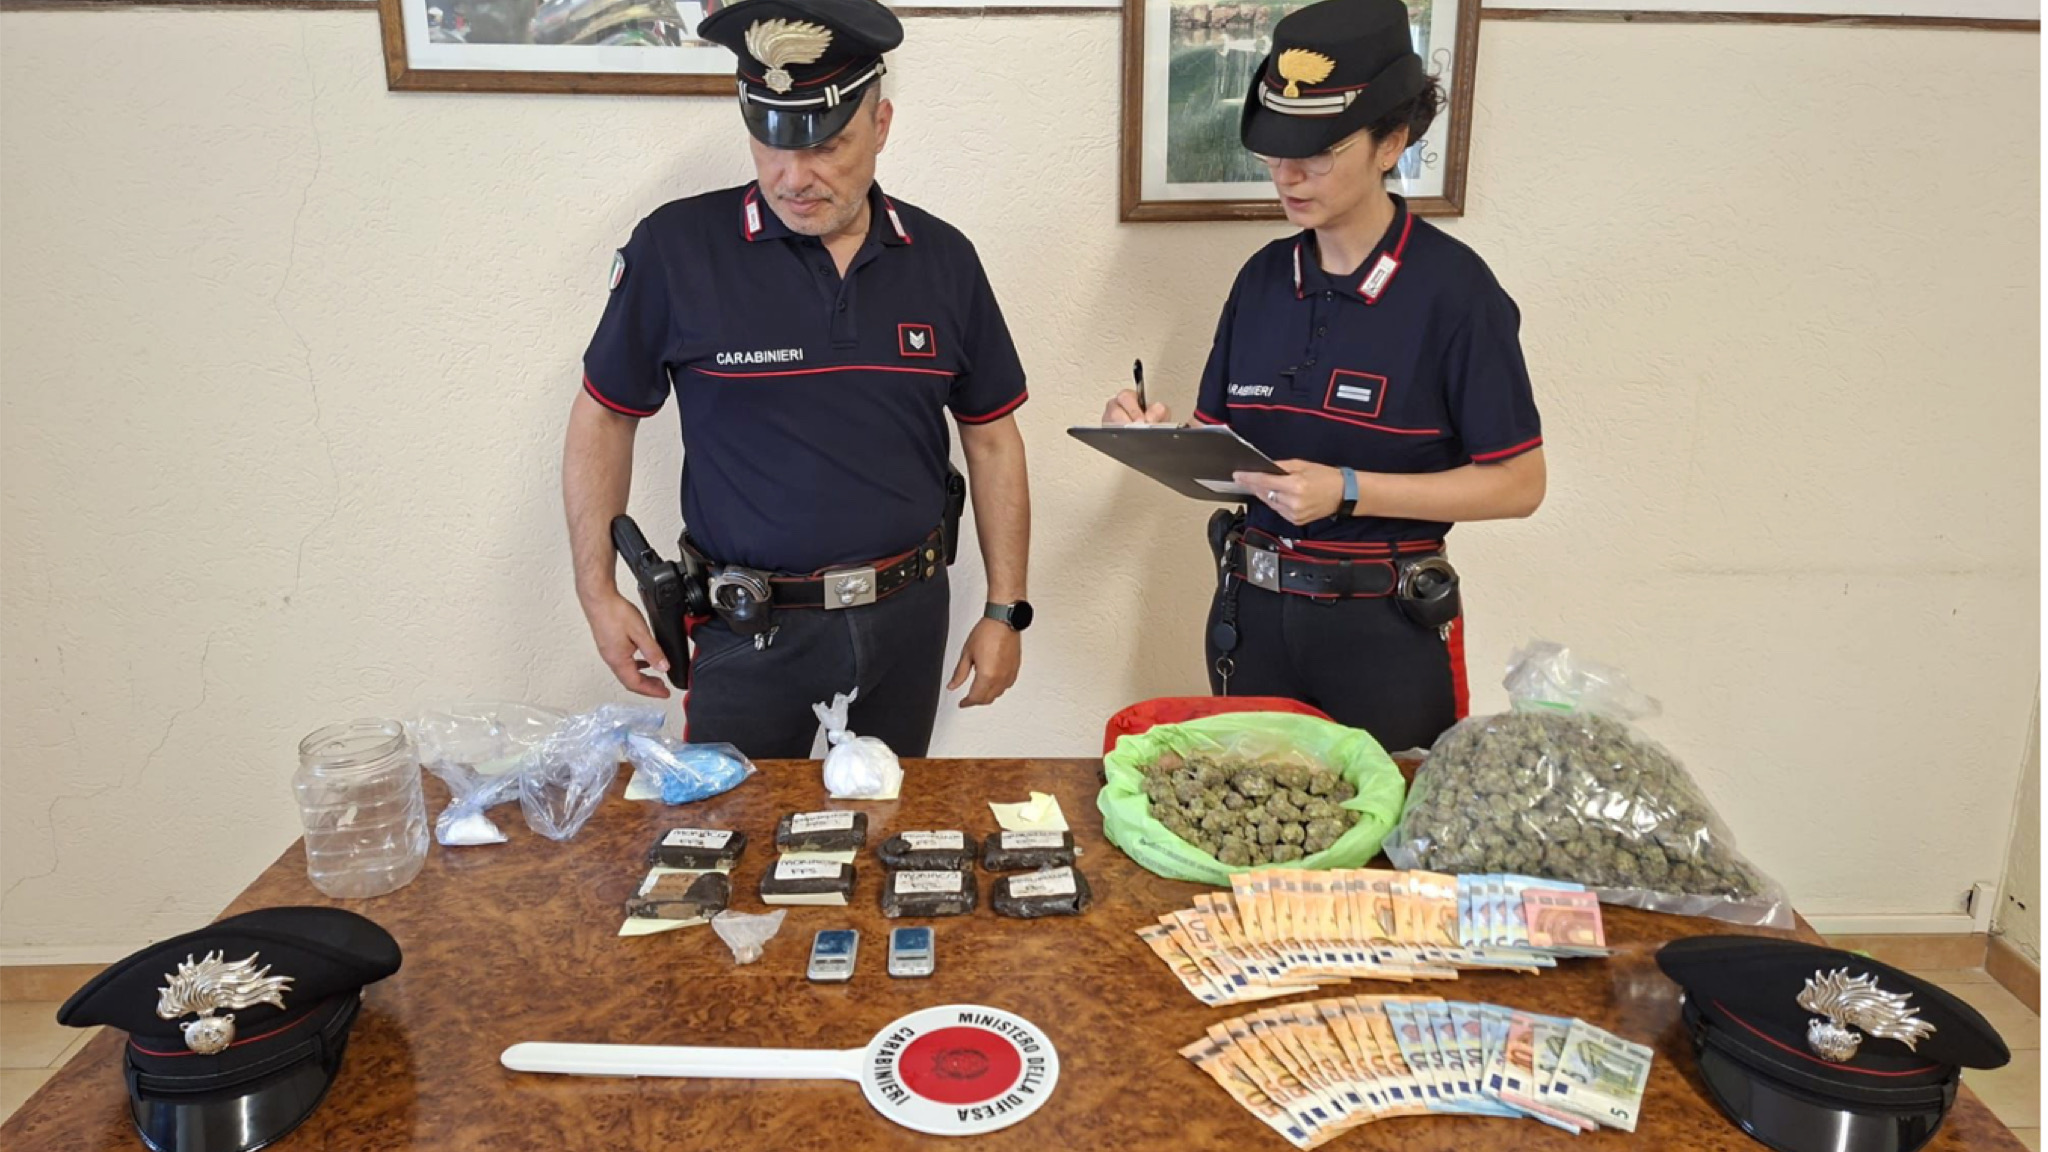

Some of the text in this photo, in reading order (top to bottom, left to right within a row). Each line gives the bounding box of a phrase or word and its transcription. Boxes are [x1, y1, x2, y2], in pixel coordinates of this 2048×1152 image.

[716, 348, 803, 365] CARABINIERI
[873, 1025, 917, 1107] CARABINIERI
[956, 1012, 1046, 1123] MINISTERO DELLA DIFESA
[1610, 1107, 1630, 1121] 5
